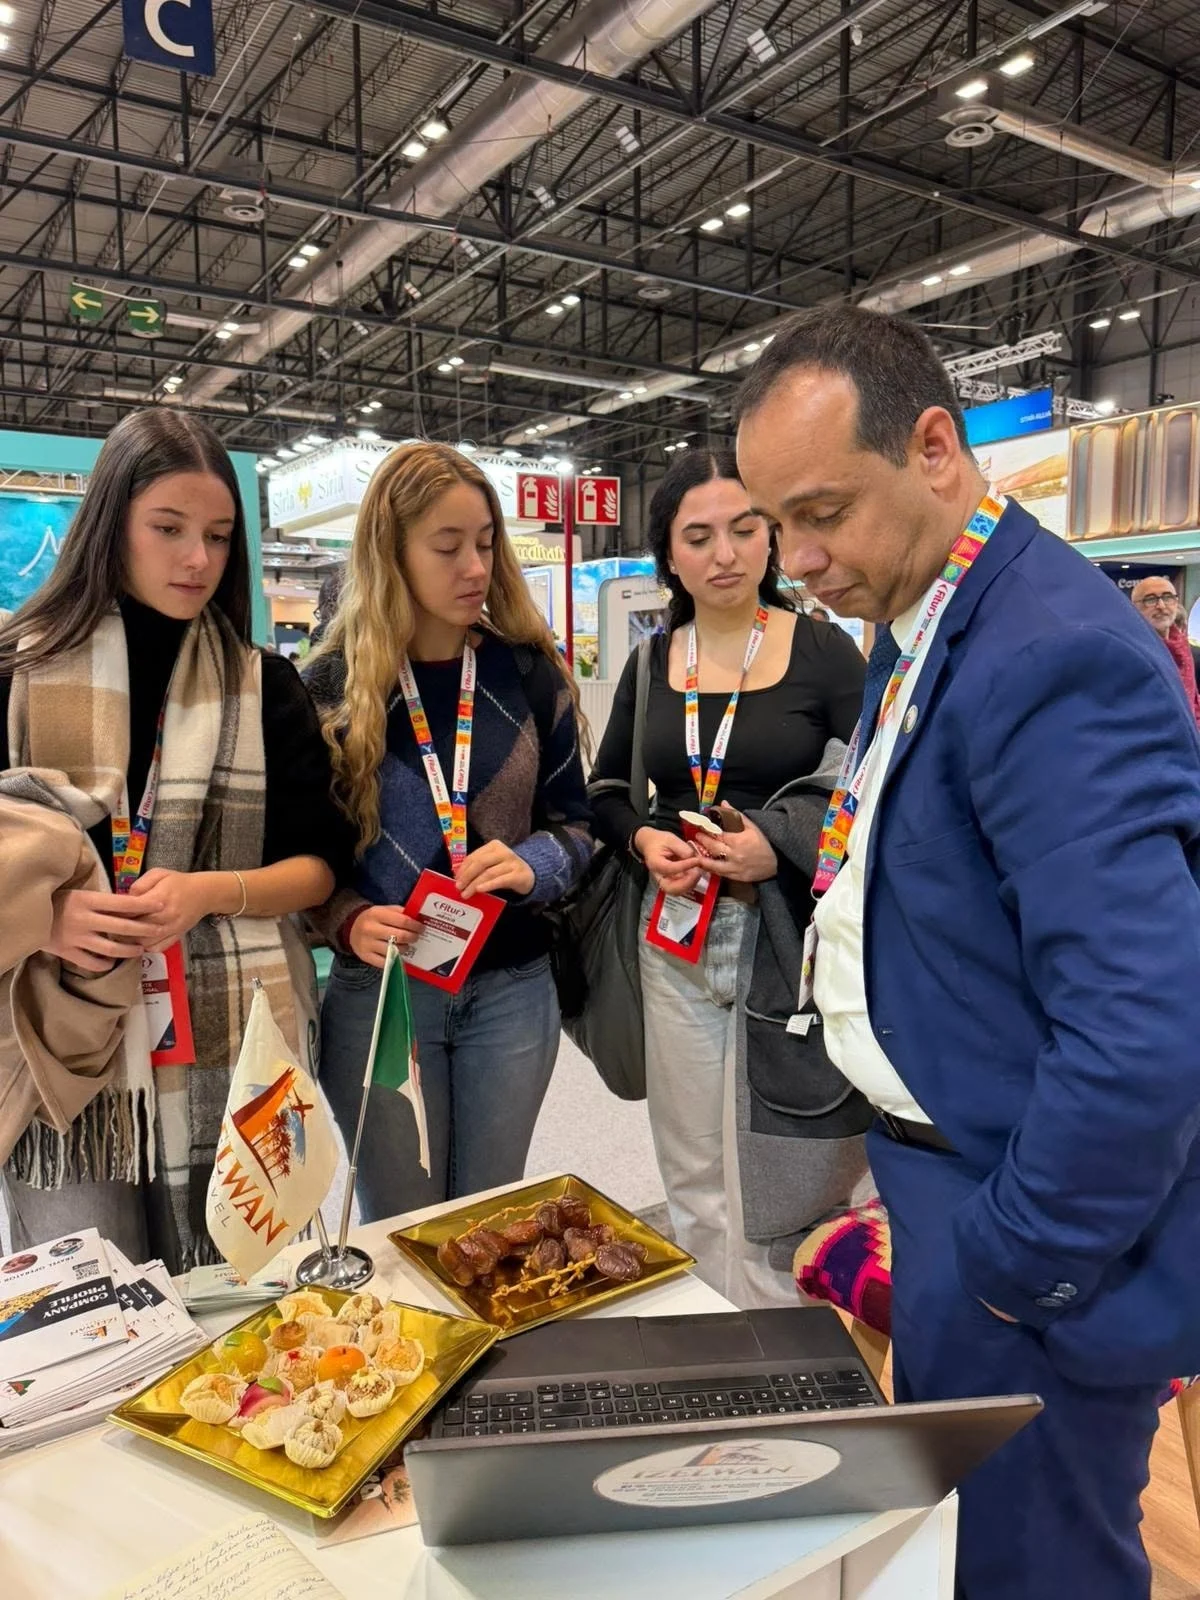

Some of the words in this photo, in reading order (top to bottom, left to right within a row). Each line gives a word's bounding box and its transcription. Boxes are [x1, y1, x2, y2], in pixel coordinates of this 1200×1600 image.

[144, 0, 195, 57] C
[318, 470, 344, 500] Siria
[929, 589, 946, 613] Fitur
[439, 902, 461, 916] Fitur
[216, 1126, 290, 1247] LWAN
[43, 1292, 109, 1319] COMPANY
[49, 1284, 107, 1308] PROFILE
[632, 1465, 793, 1479] IZELWAN
